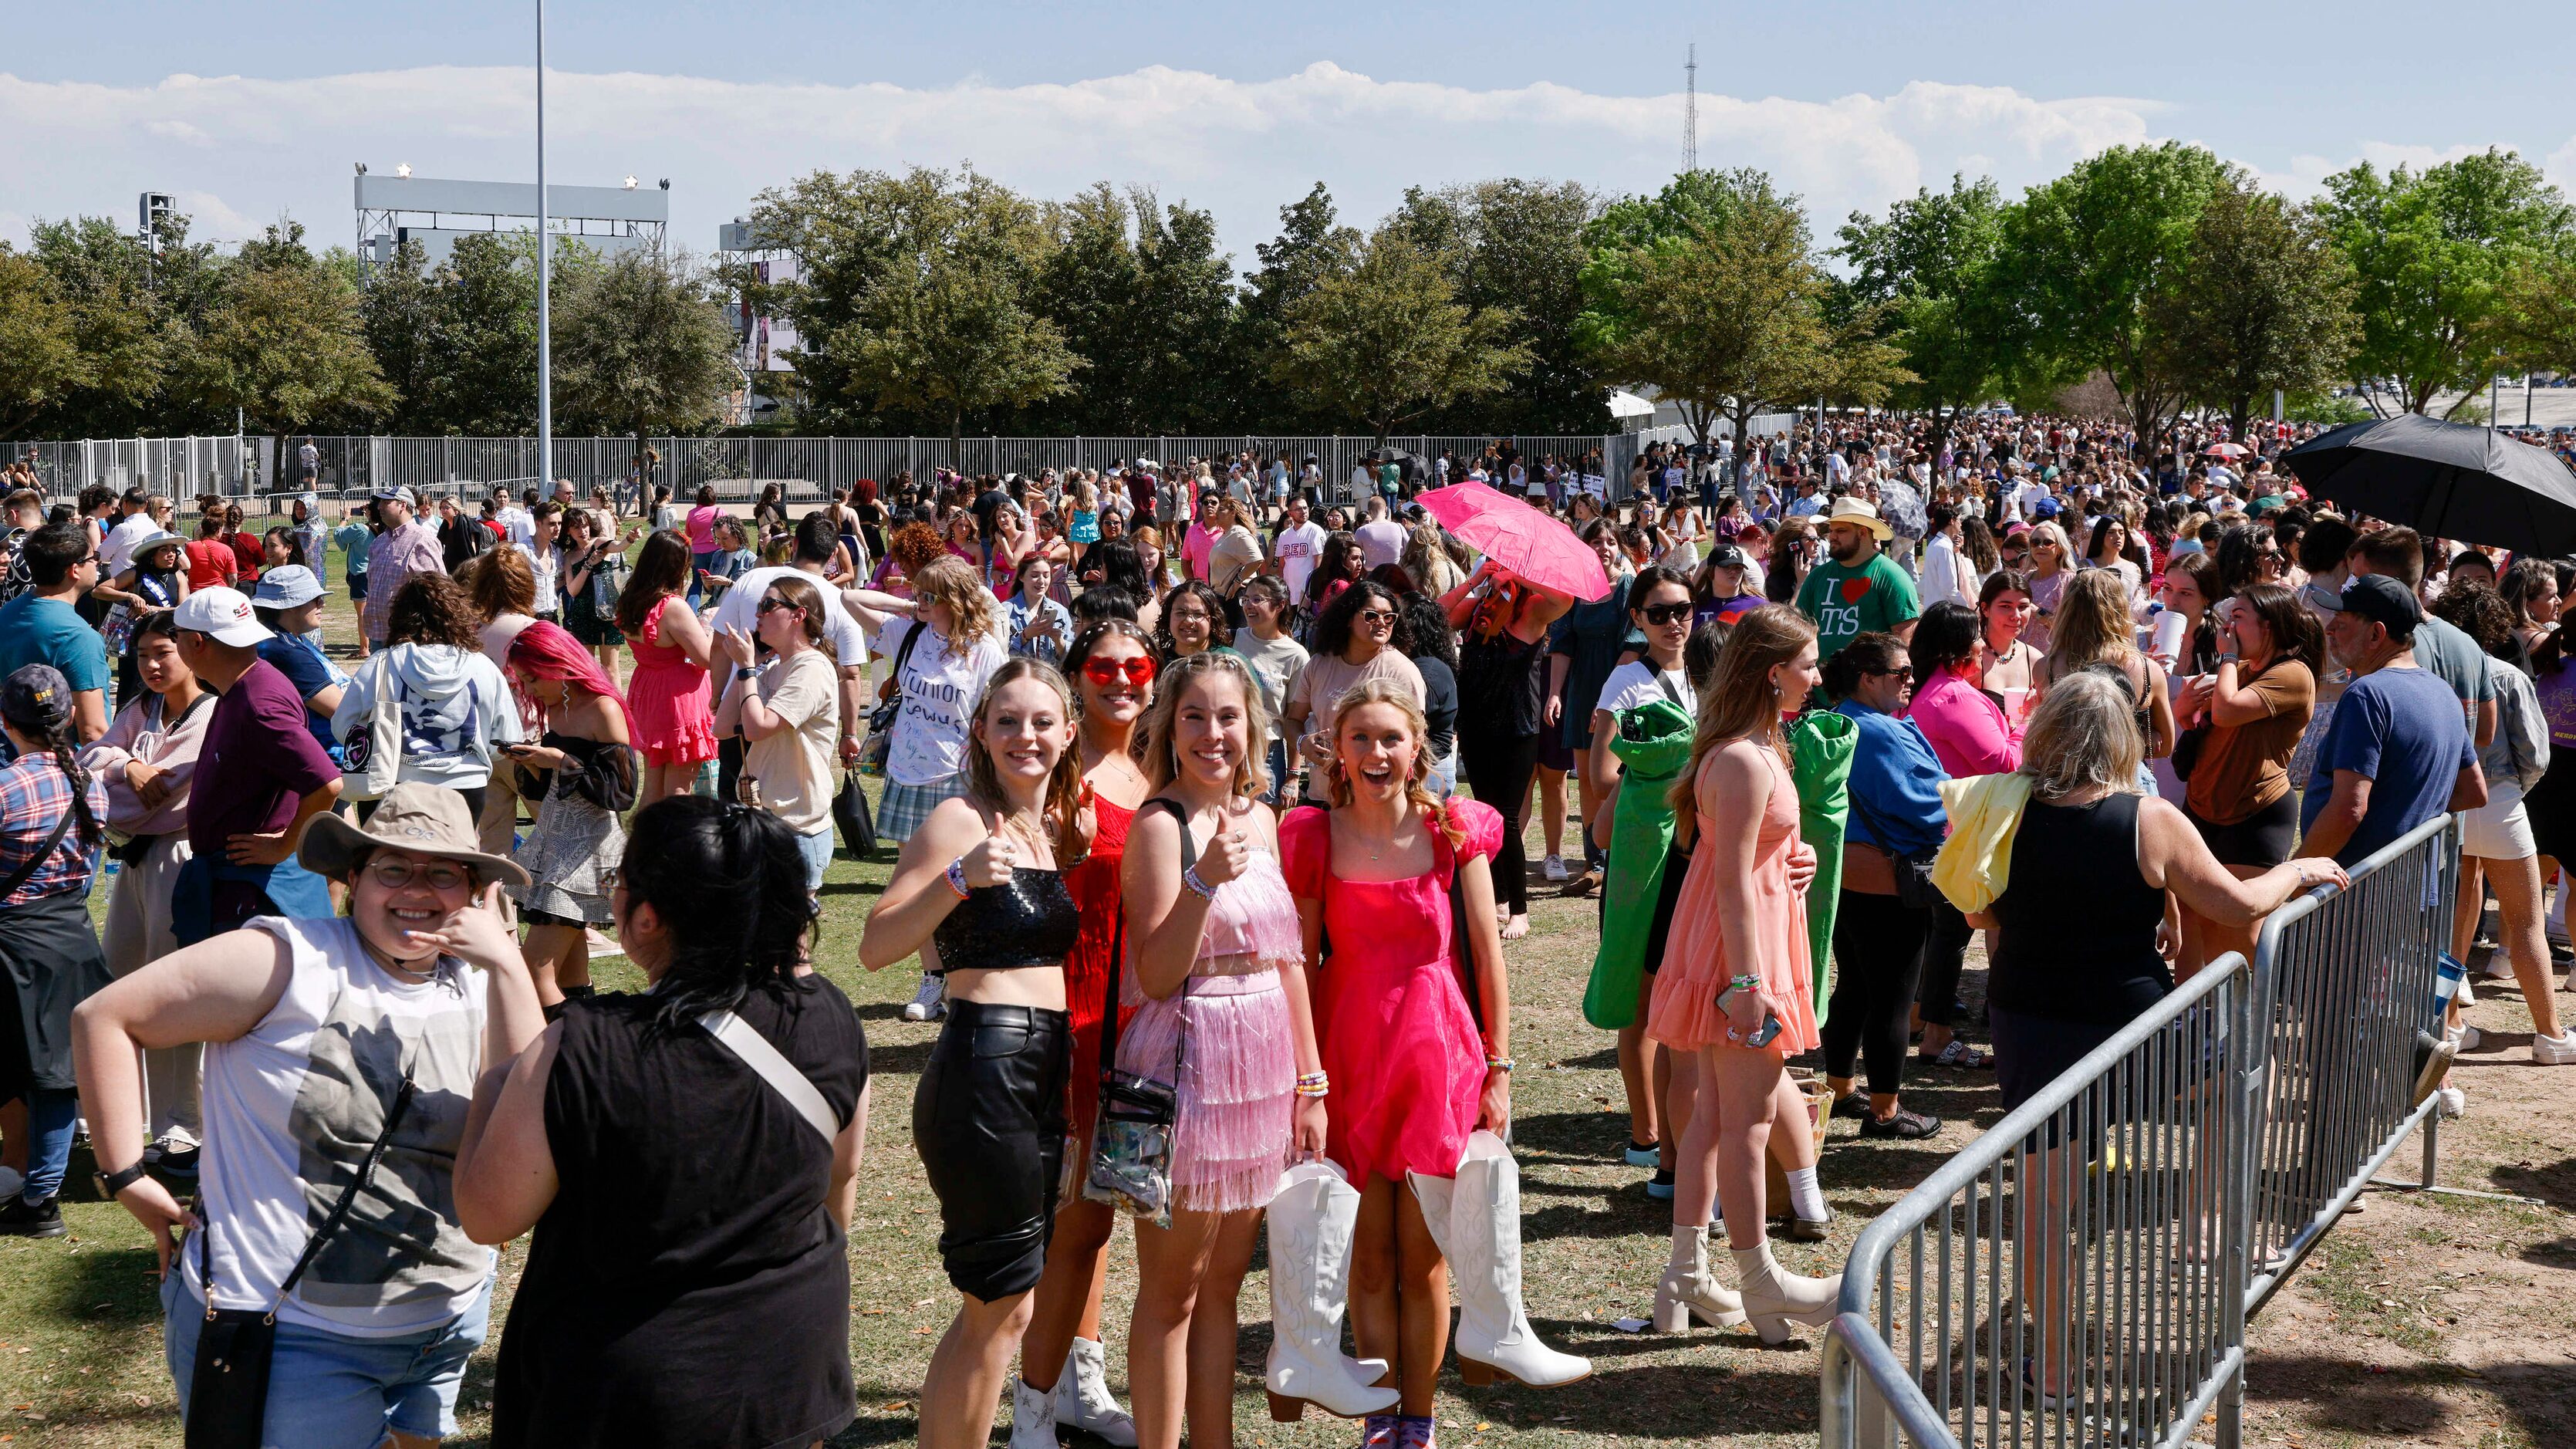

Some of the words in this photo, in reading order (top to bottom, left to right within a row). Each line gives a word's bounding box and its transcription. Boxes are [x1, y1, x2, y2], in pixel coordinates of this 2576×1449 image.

[1284, 542, 1308, 556] RED
[1821, 577, 1839, 606] I
[1821, 606, 1859, 636] TS
[902, 666, 966, 705] Junior
[571, 843, 588, 863] Body
